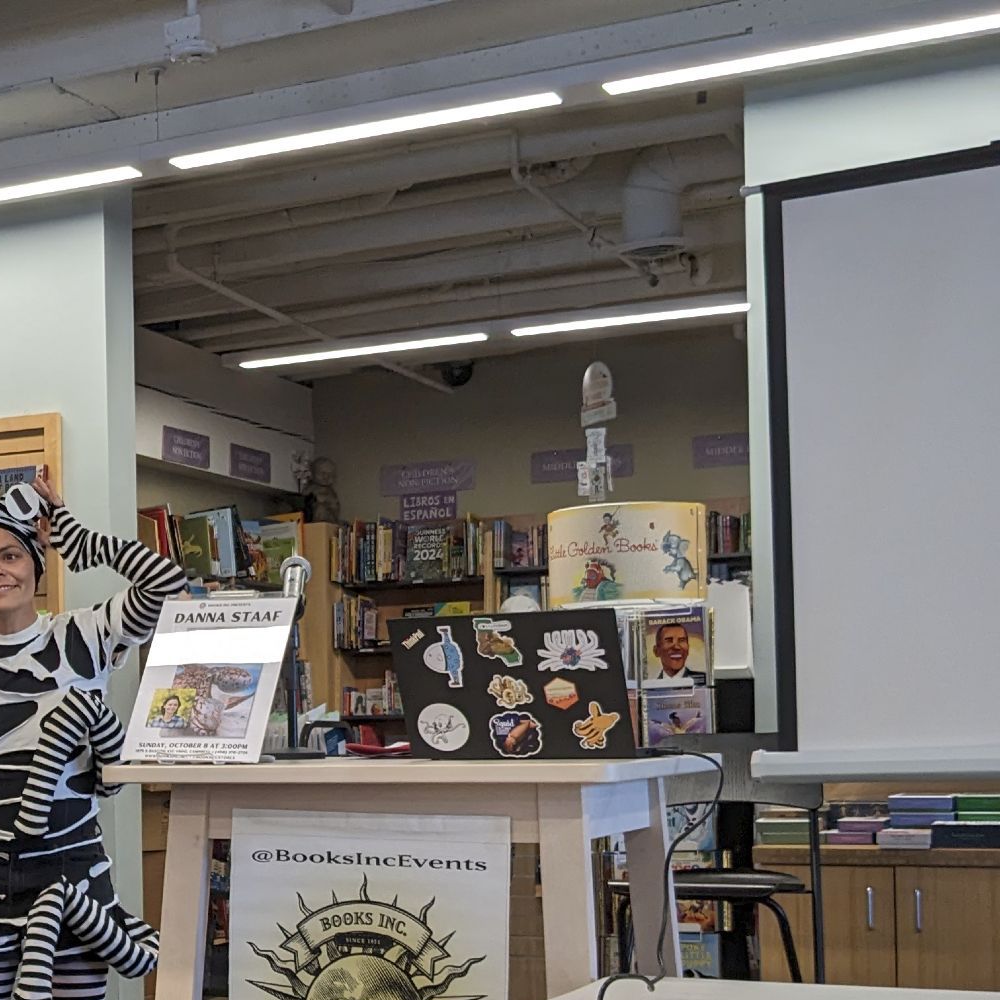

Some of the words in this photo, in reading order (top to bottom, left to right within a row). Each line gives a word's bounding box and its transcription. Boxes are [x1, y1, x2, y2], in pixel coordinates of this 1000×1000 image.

[5, 473, 24, 483] LAND
[404, 496, 440, 508] LIBROS
[444, 496, 455, 504] EN
[403, 507, 451, 520] ESPAÑOL
[568, 541, 611, 557] Golden
[614, 537, 658, 553] Books
[413, 549, 443, 561] 2024
[174, 612, 226, 624] DANNA
[231, 611, 283, 623] STAAF
[676, 616, 702, 624] OBAMA
[252, 849, 487, 872] @BooksIncEvents
[319, 911, 373, 932] BOOKS
[377, 913, 407, 937] INC.
